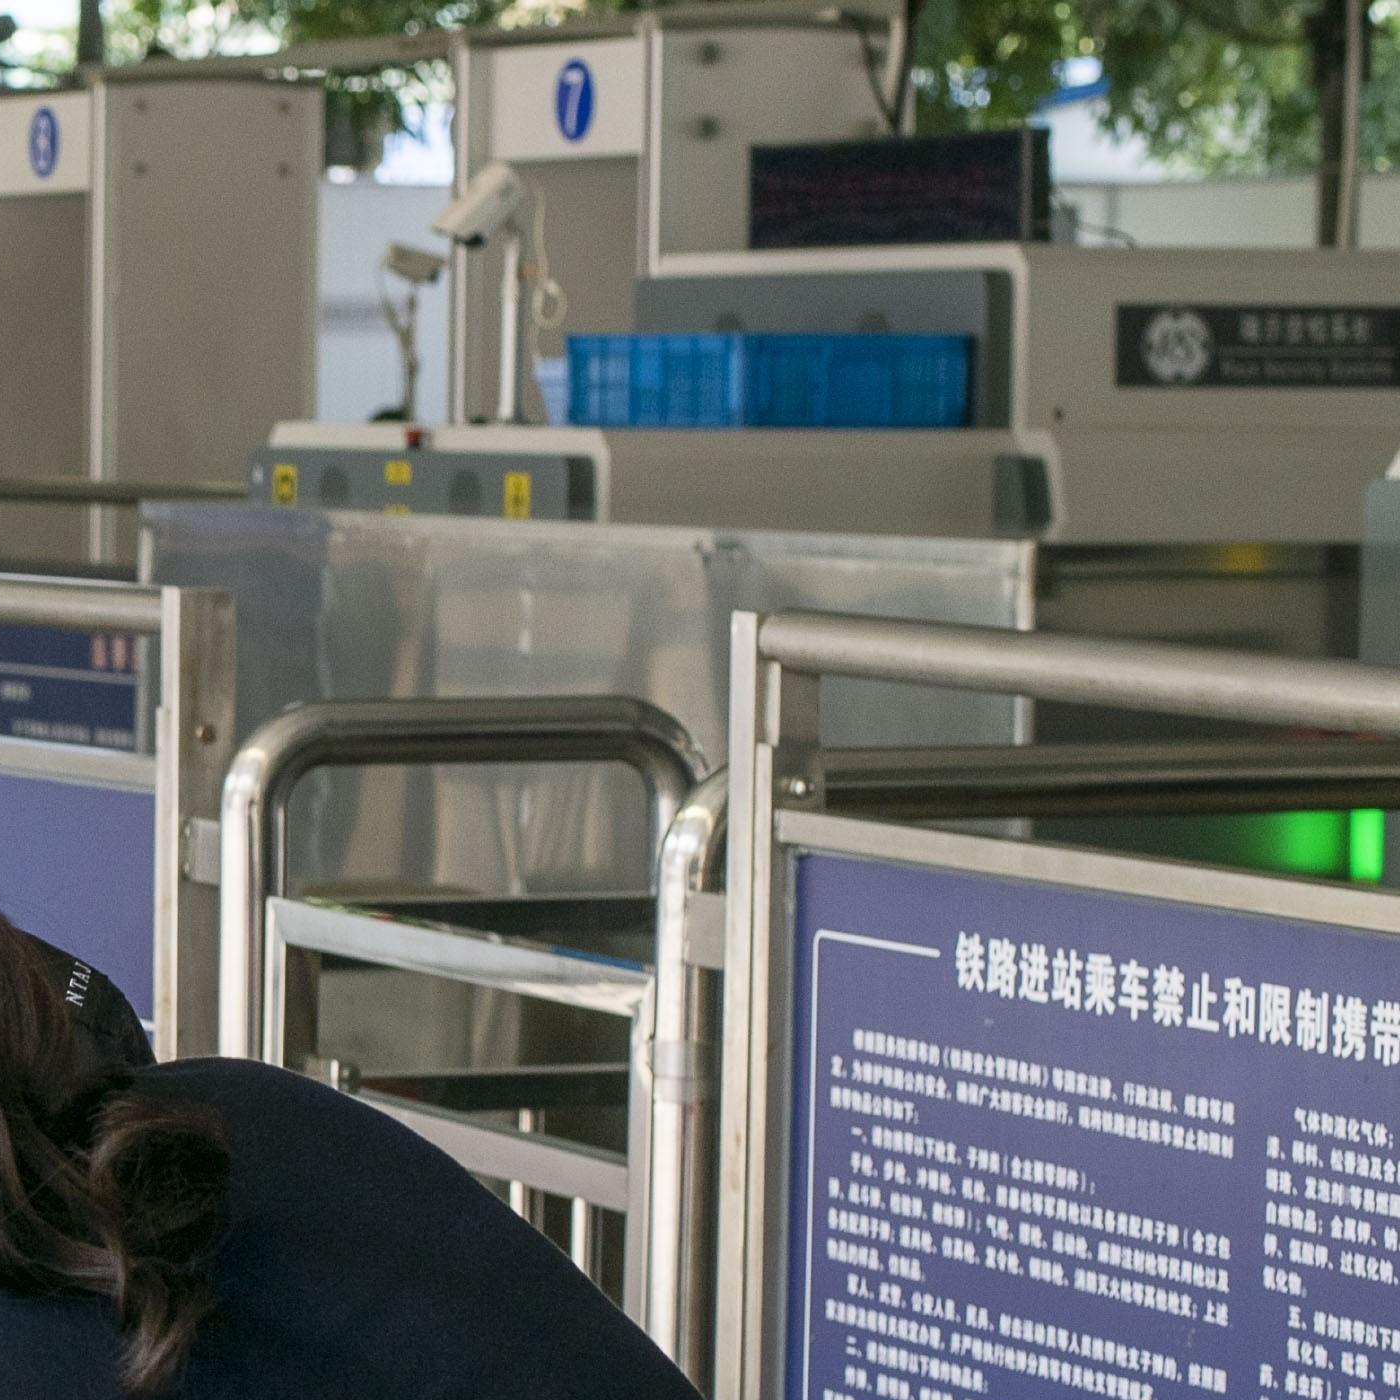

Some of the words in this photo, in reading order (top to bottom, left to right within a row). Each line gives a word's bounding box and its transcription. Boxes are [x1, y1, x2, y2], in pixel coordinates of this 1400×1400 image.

[65, 961, 92, 1007] NTAJ
[956, 931, 1400, 1067] 铁路进站乘车禁止和限制携带
